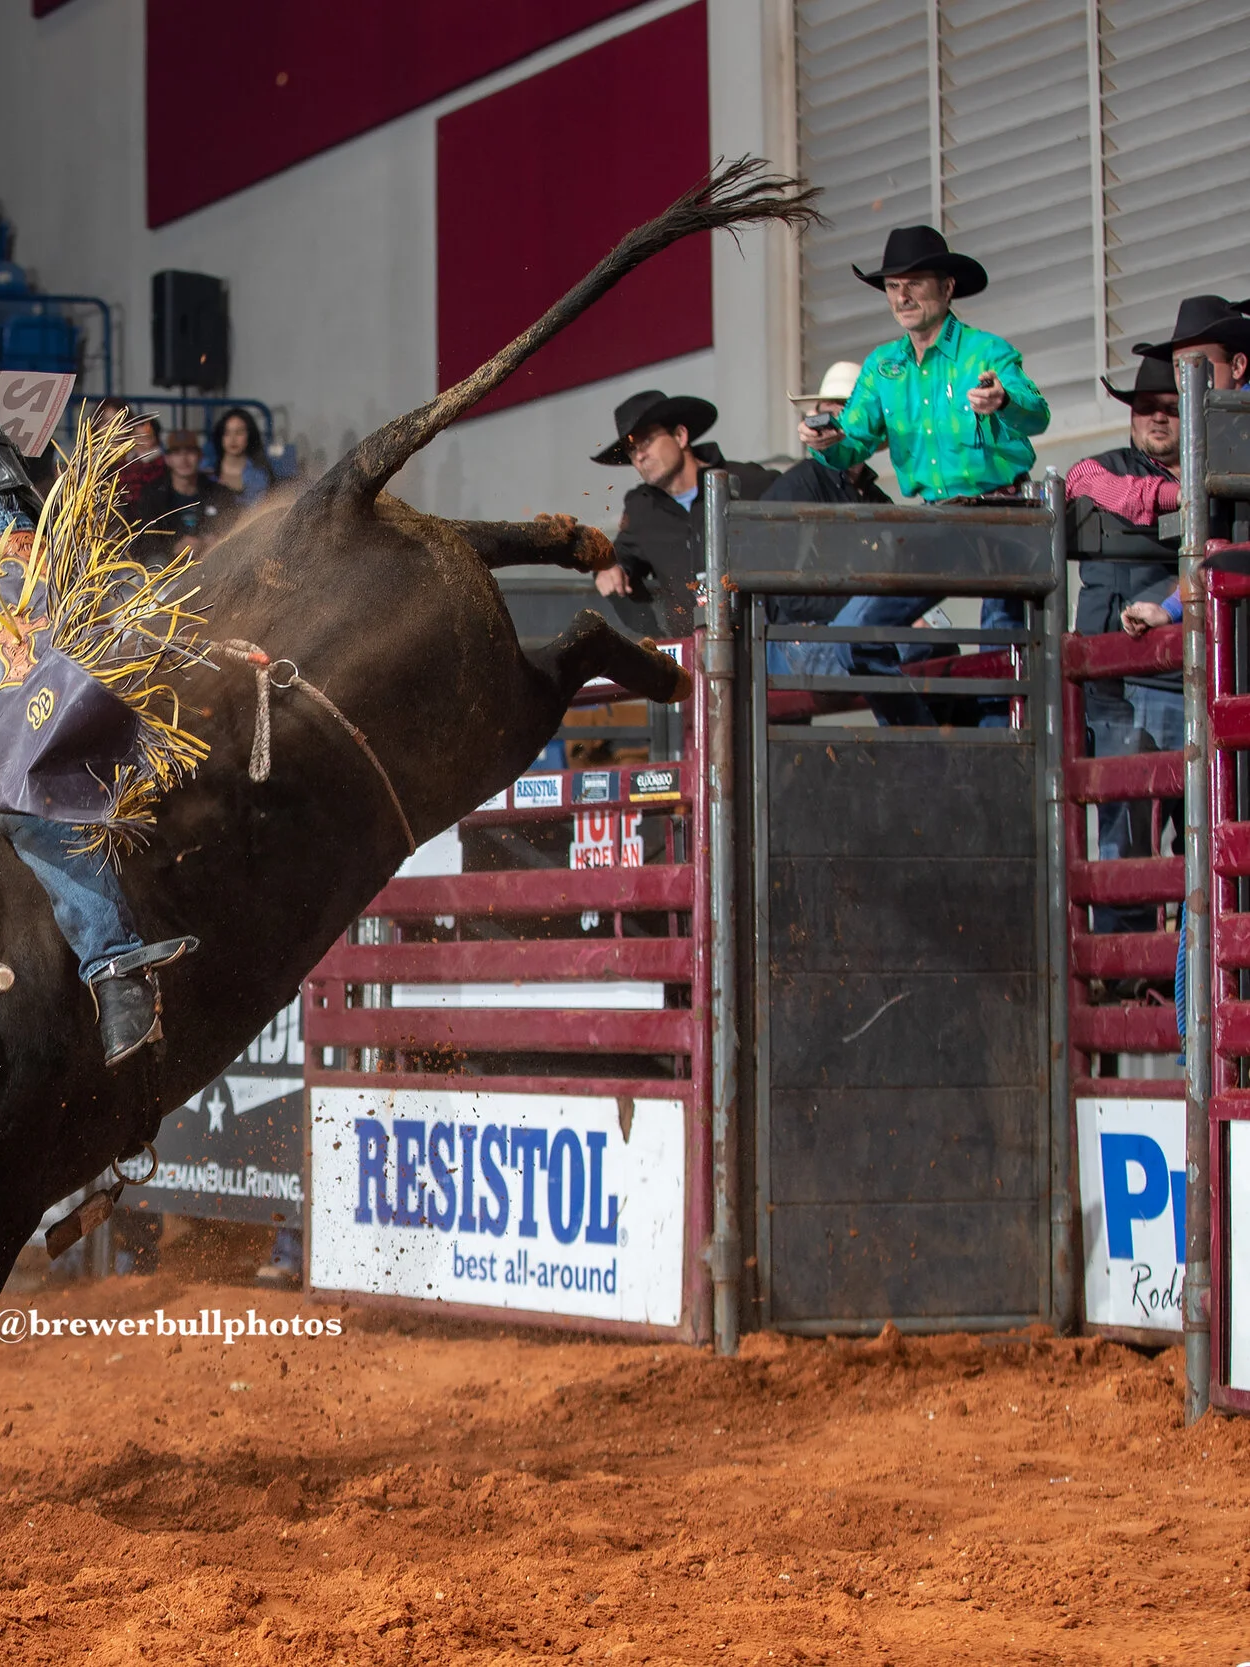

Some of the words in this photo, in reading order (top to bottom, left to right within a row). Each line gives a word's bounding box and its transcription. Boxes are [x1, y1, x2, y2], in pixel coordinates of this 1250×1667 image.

[354, 1117, 618, 1246] RESISTOL
[453, 1242, 498, 1281] best
[504, 1249, 617, 1295] all-around
